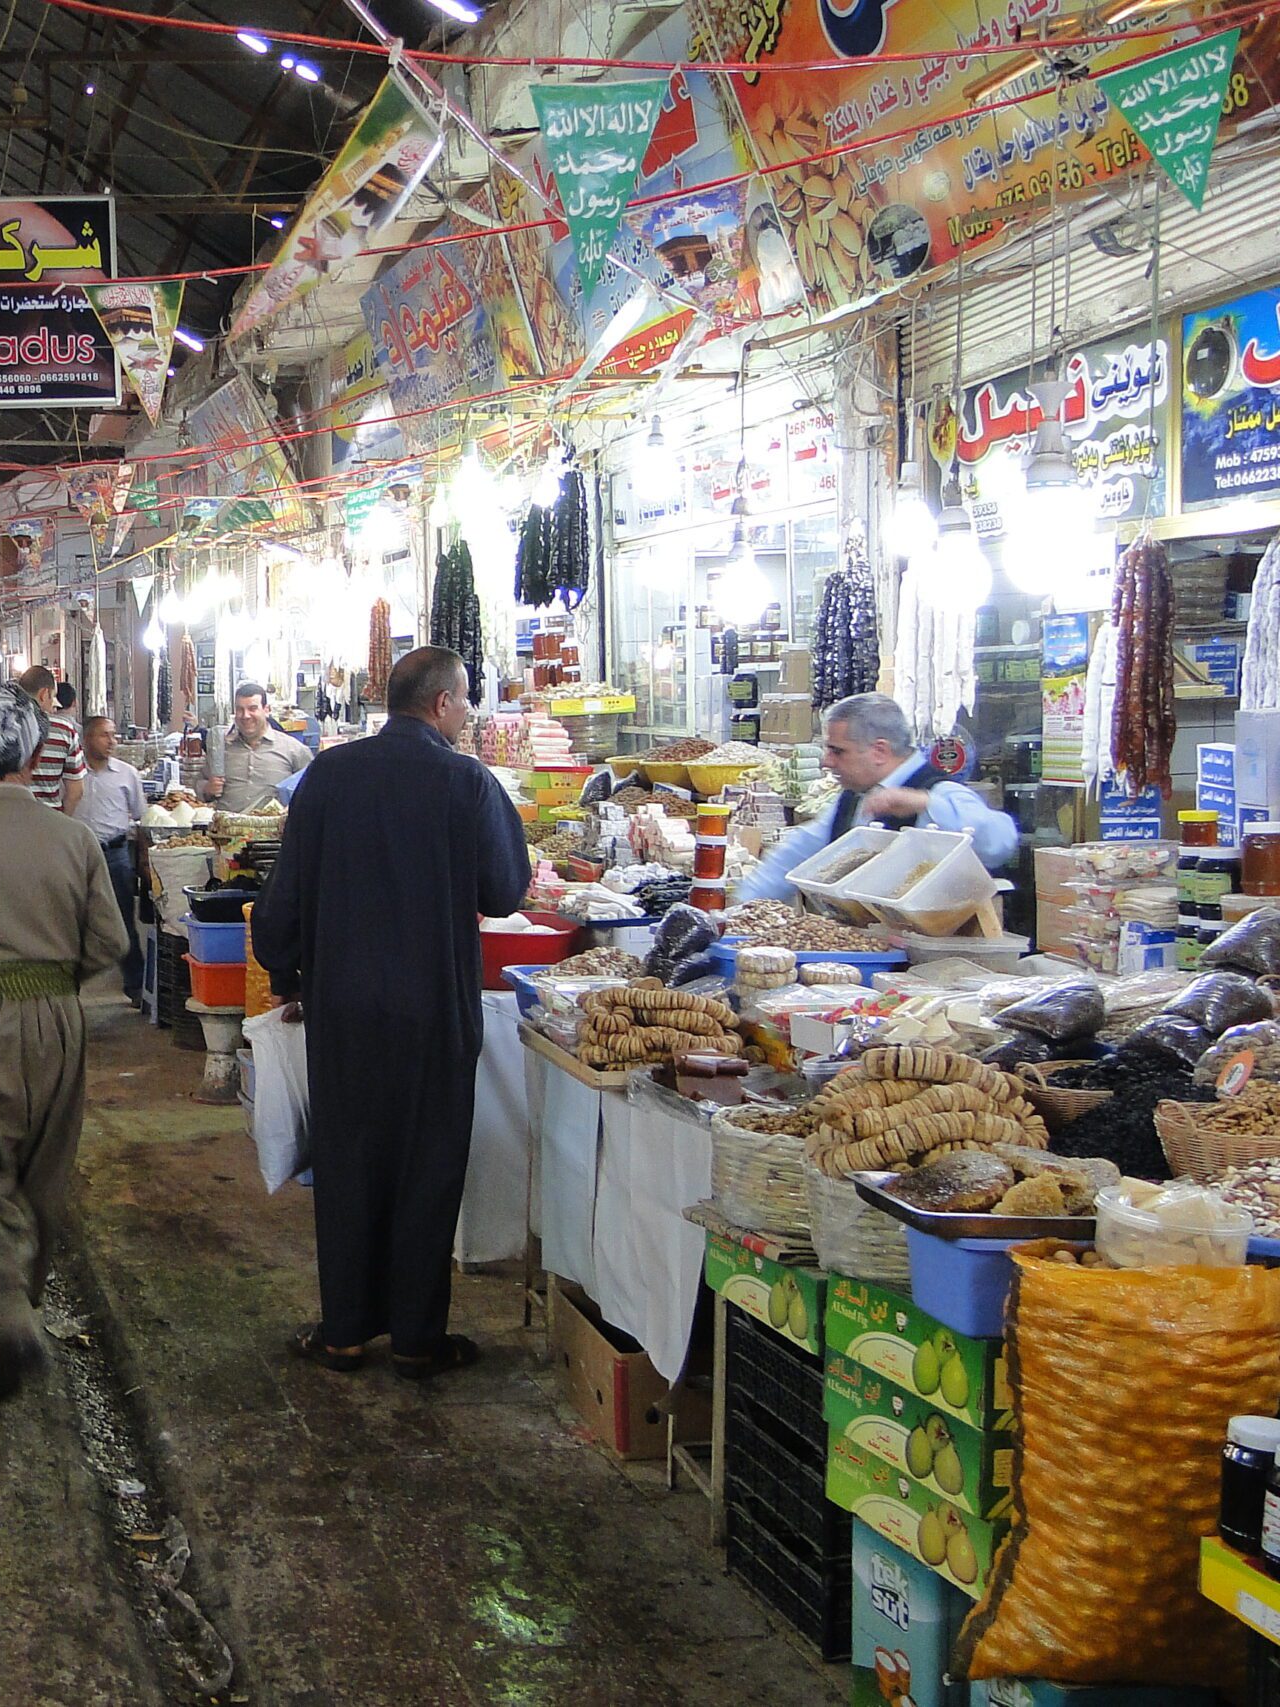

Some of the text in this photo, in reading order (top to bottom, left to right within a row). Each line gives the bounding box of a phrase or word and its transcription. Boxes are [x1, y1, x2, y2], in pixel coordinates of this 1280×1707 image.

[1096, 129, 1139, 175] Tel:
[1215, 452, 1242, 470] Mob
[871, 1552, 909, 1596] tek
[871, 1586, 910, 1632] süt
